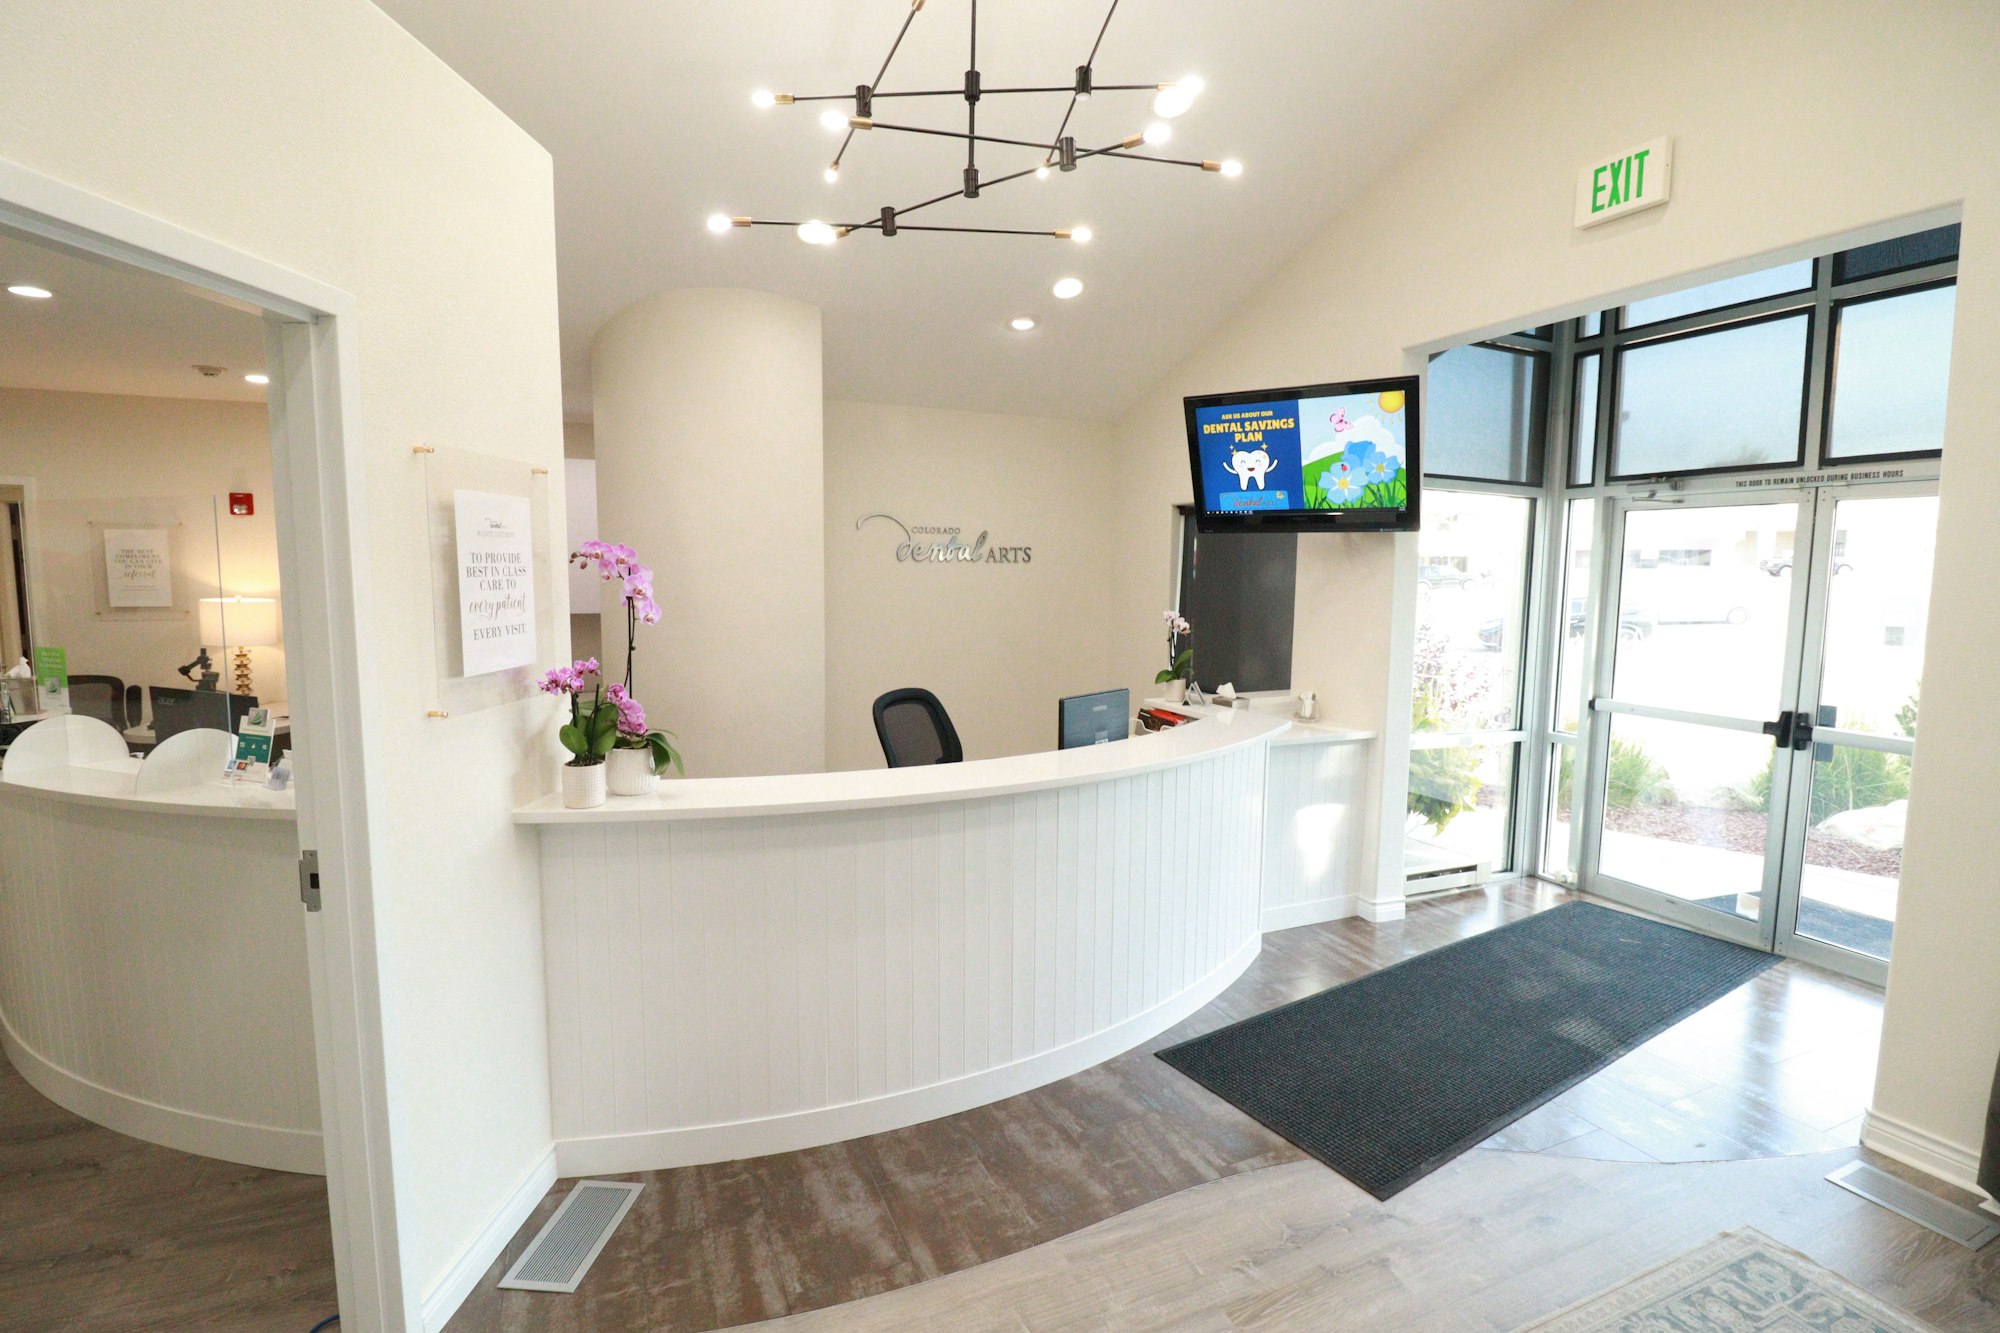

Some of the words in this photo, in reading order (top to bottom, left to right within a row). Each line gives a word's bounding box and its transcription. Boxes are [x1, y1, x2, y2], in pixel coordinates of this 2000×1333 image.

[1591, 149, 1650, 213] EXIT
[1233, 411, 1240, 419] US
[1203, 421, 1243, 434] DENTAL
[1244, 418, 1294, 430] SAVINGS
[1235, 432, 1263, 443] PLAN
[1773, 478, 1794, 486] REMAIN
[1796, 475, 1824, 484] UNLOCKED
[1826, 474, 1848, 482] DURING
[1850, 472, 1880, 480] BUSINESS
[1882, 470, 1904, 478] HOURS
[911, 526, 961, 535] COLORADO
[470, 552, 482, 564] TO
[485, 552, 522, 564] PROVIDE
[985, 546, 1032, 563] ARTS
[466, 566, 488, 578] BEST
[490, 566, 500, 577] IN
[502, 565, 527, 577] CLASS
[479, 579, 504, 591] CARE
[506, 579, 516, 590] TO
[469, 599, 495, 620] every
[495, 592, 528, 621] patient
[473, 626, 502, 641] EVERY
